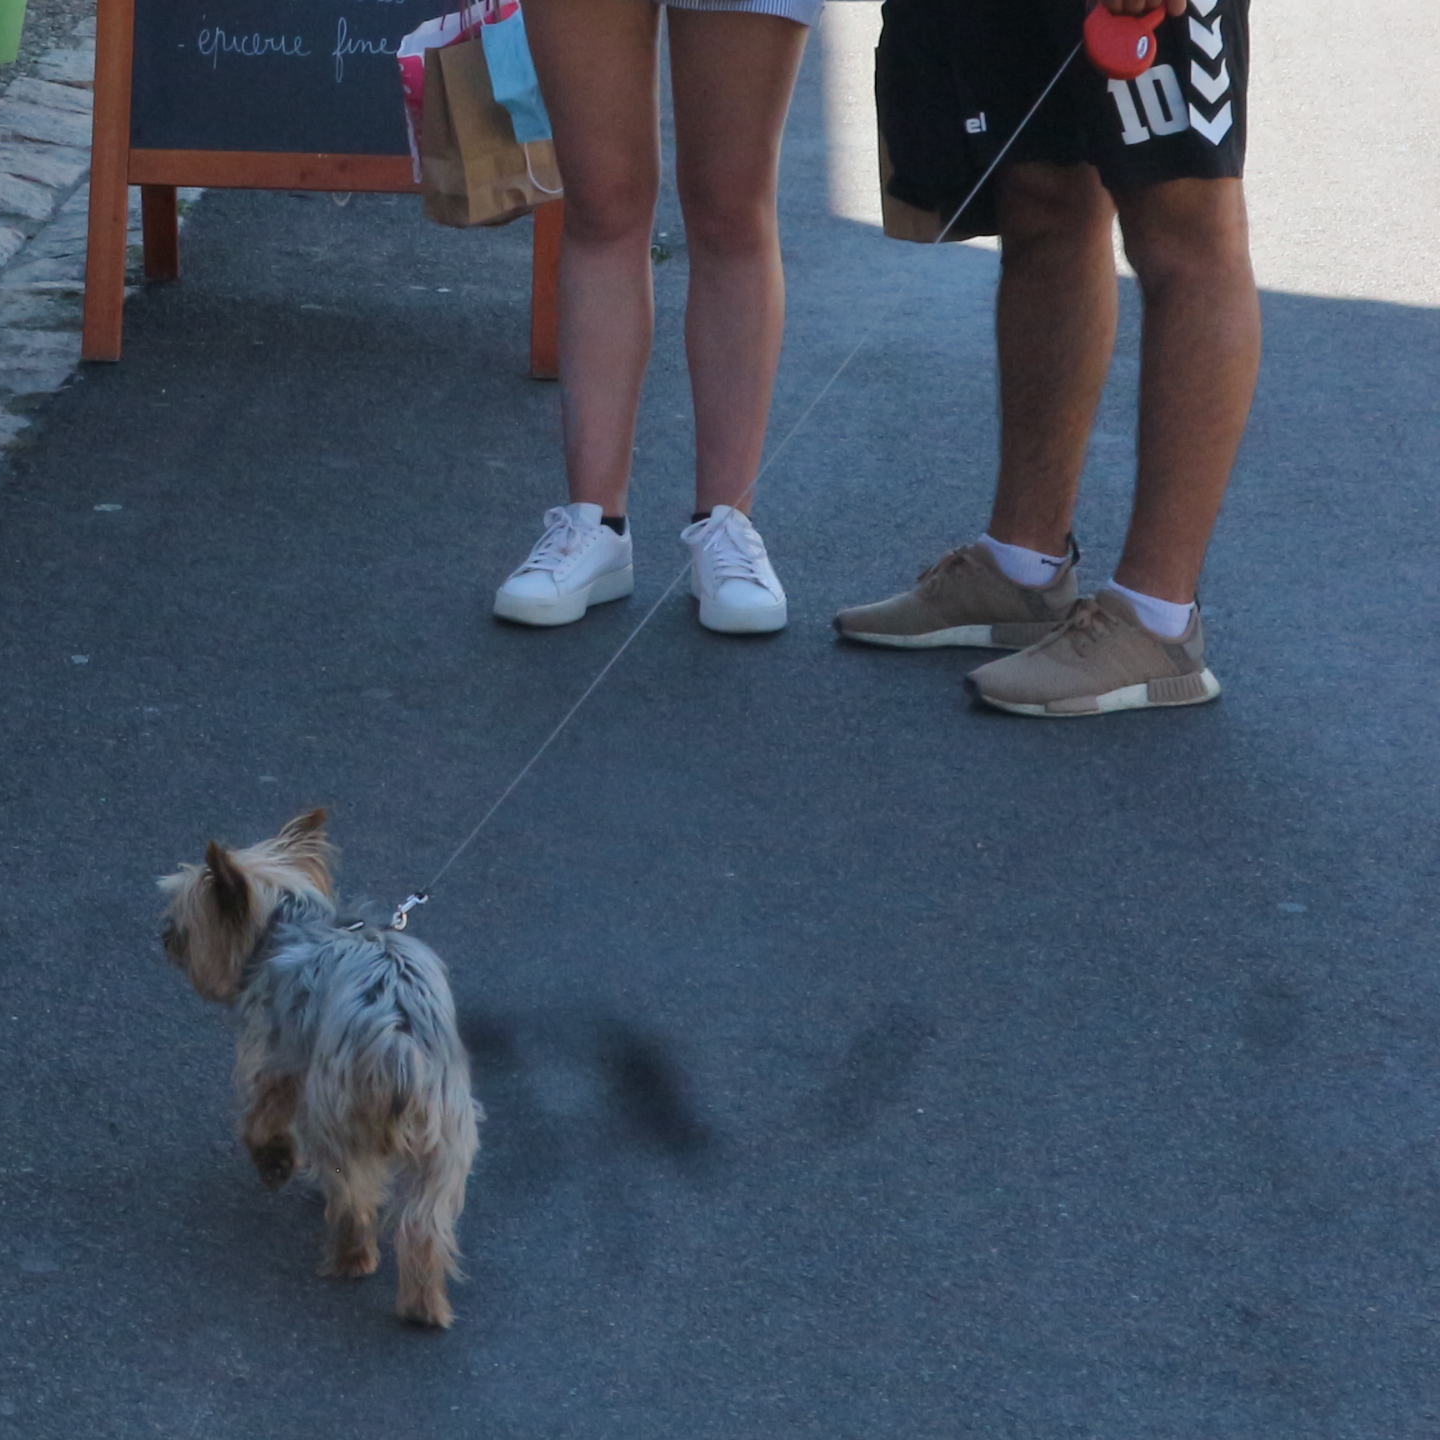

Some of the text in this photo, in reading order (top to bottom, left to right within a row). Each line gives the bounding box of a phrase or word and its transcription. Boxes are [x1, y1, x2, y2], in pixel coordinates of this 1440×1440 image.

[197, 14, 401, 84] épicerie fine
[1108, 63, 1190, 145] 10
